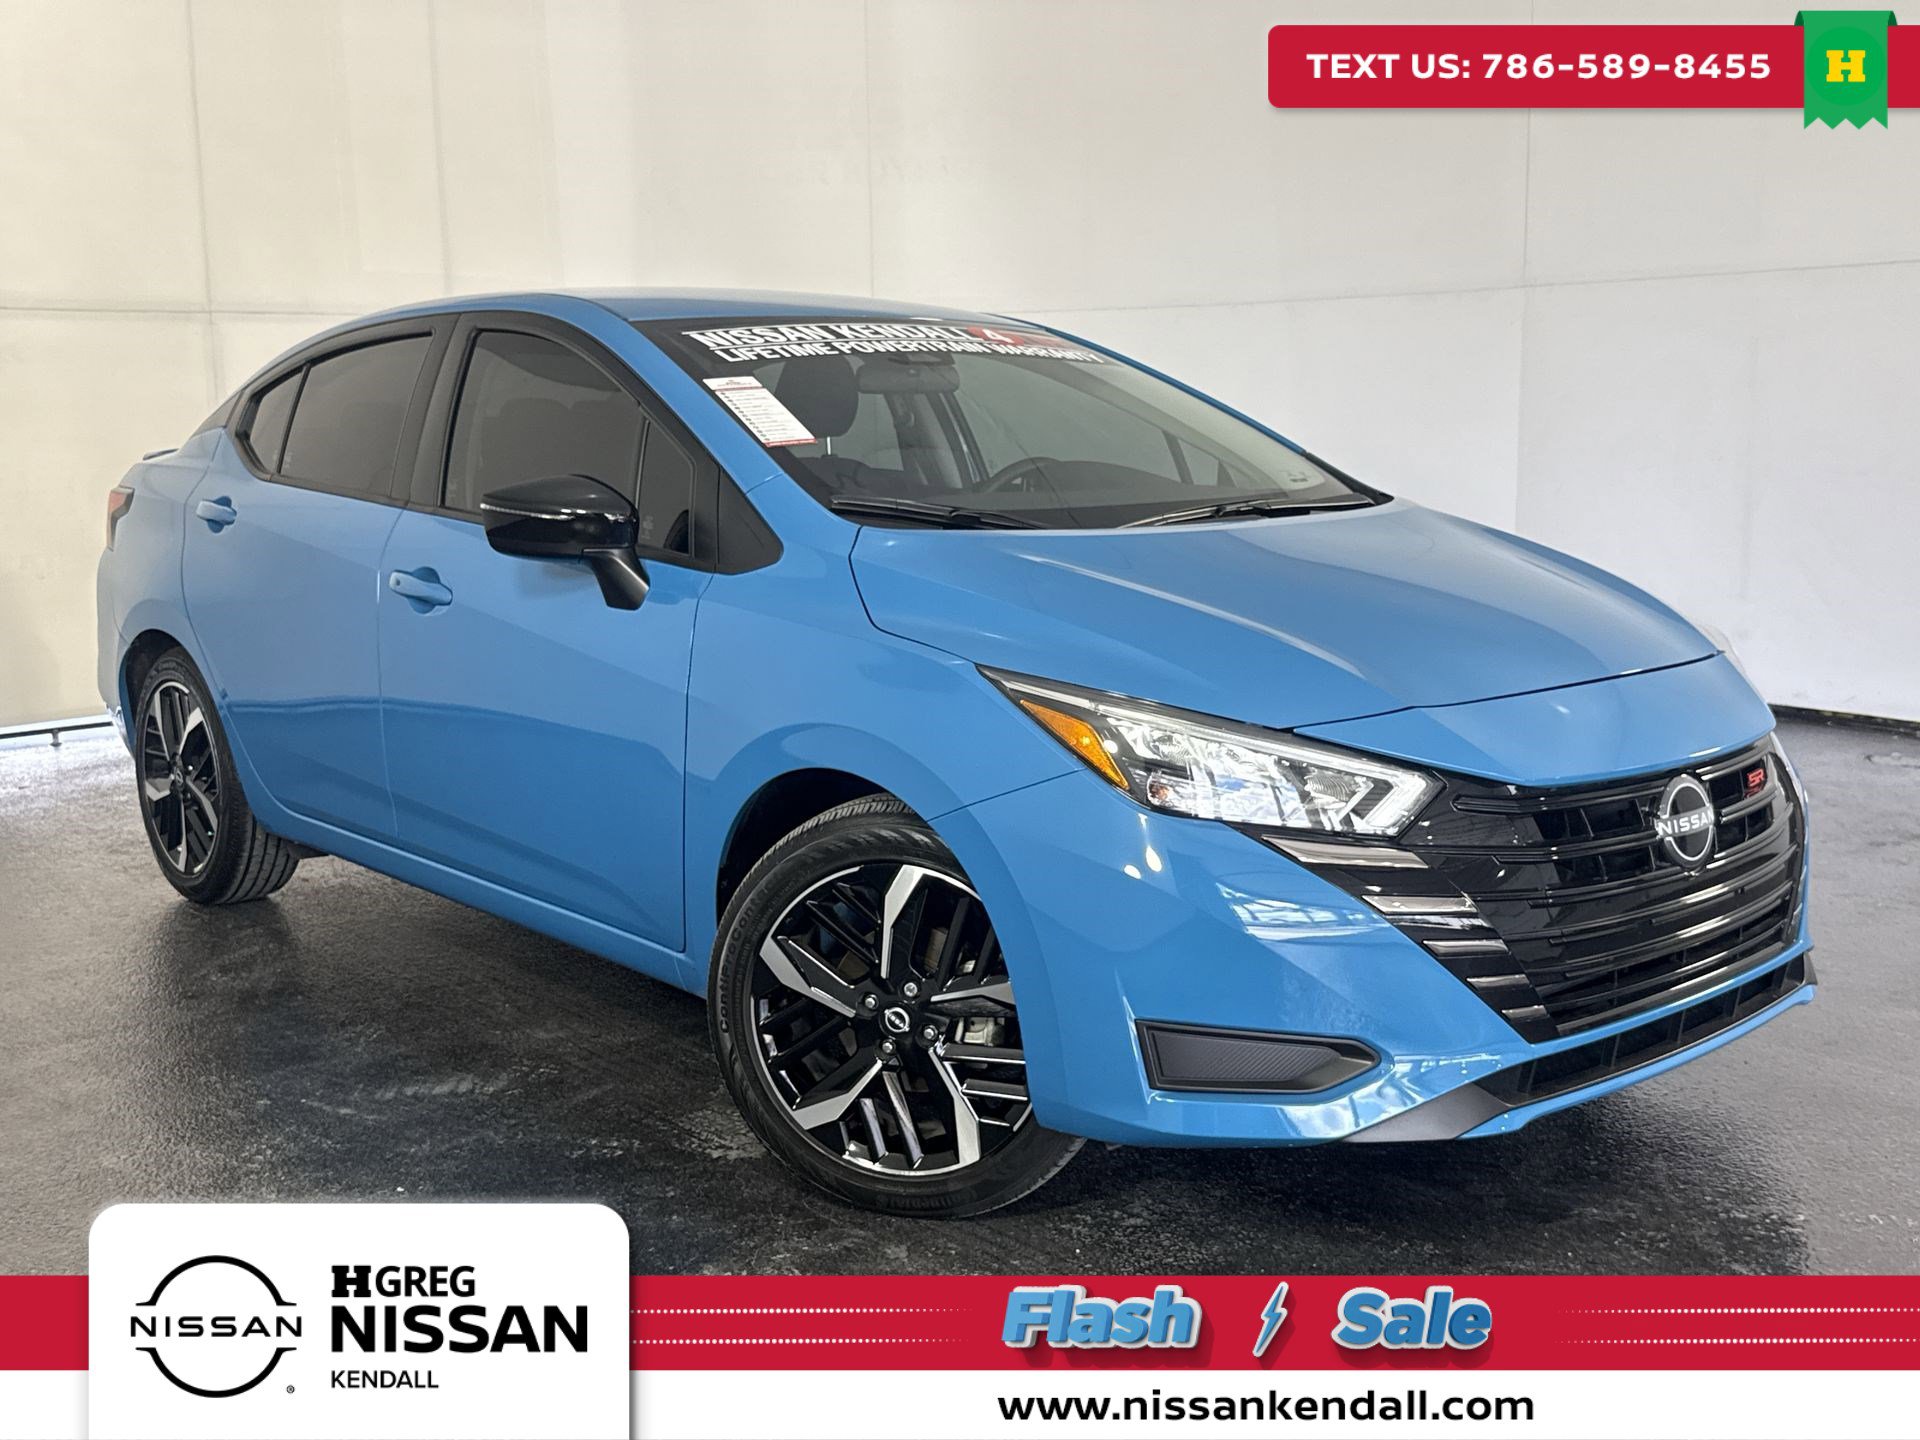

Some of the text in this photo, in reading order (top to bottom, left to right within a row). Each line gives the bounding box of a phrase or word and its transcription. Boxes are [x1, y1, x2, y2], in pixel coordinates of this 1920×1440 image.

[690, 325, 837, 347] NISSAN
[829, 324, 980, 340] KENDALL
[714, 341, 839, 362] LIFETIME
[831, 339, 992, 354] POWERTRAIN
[1656, 807, 1714, 837] NISSAN
